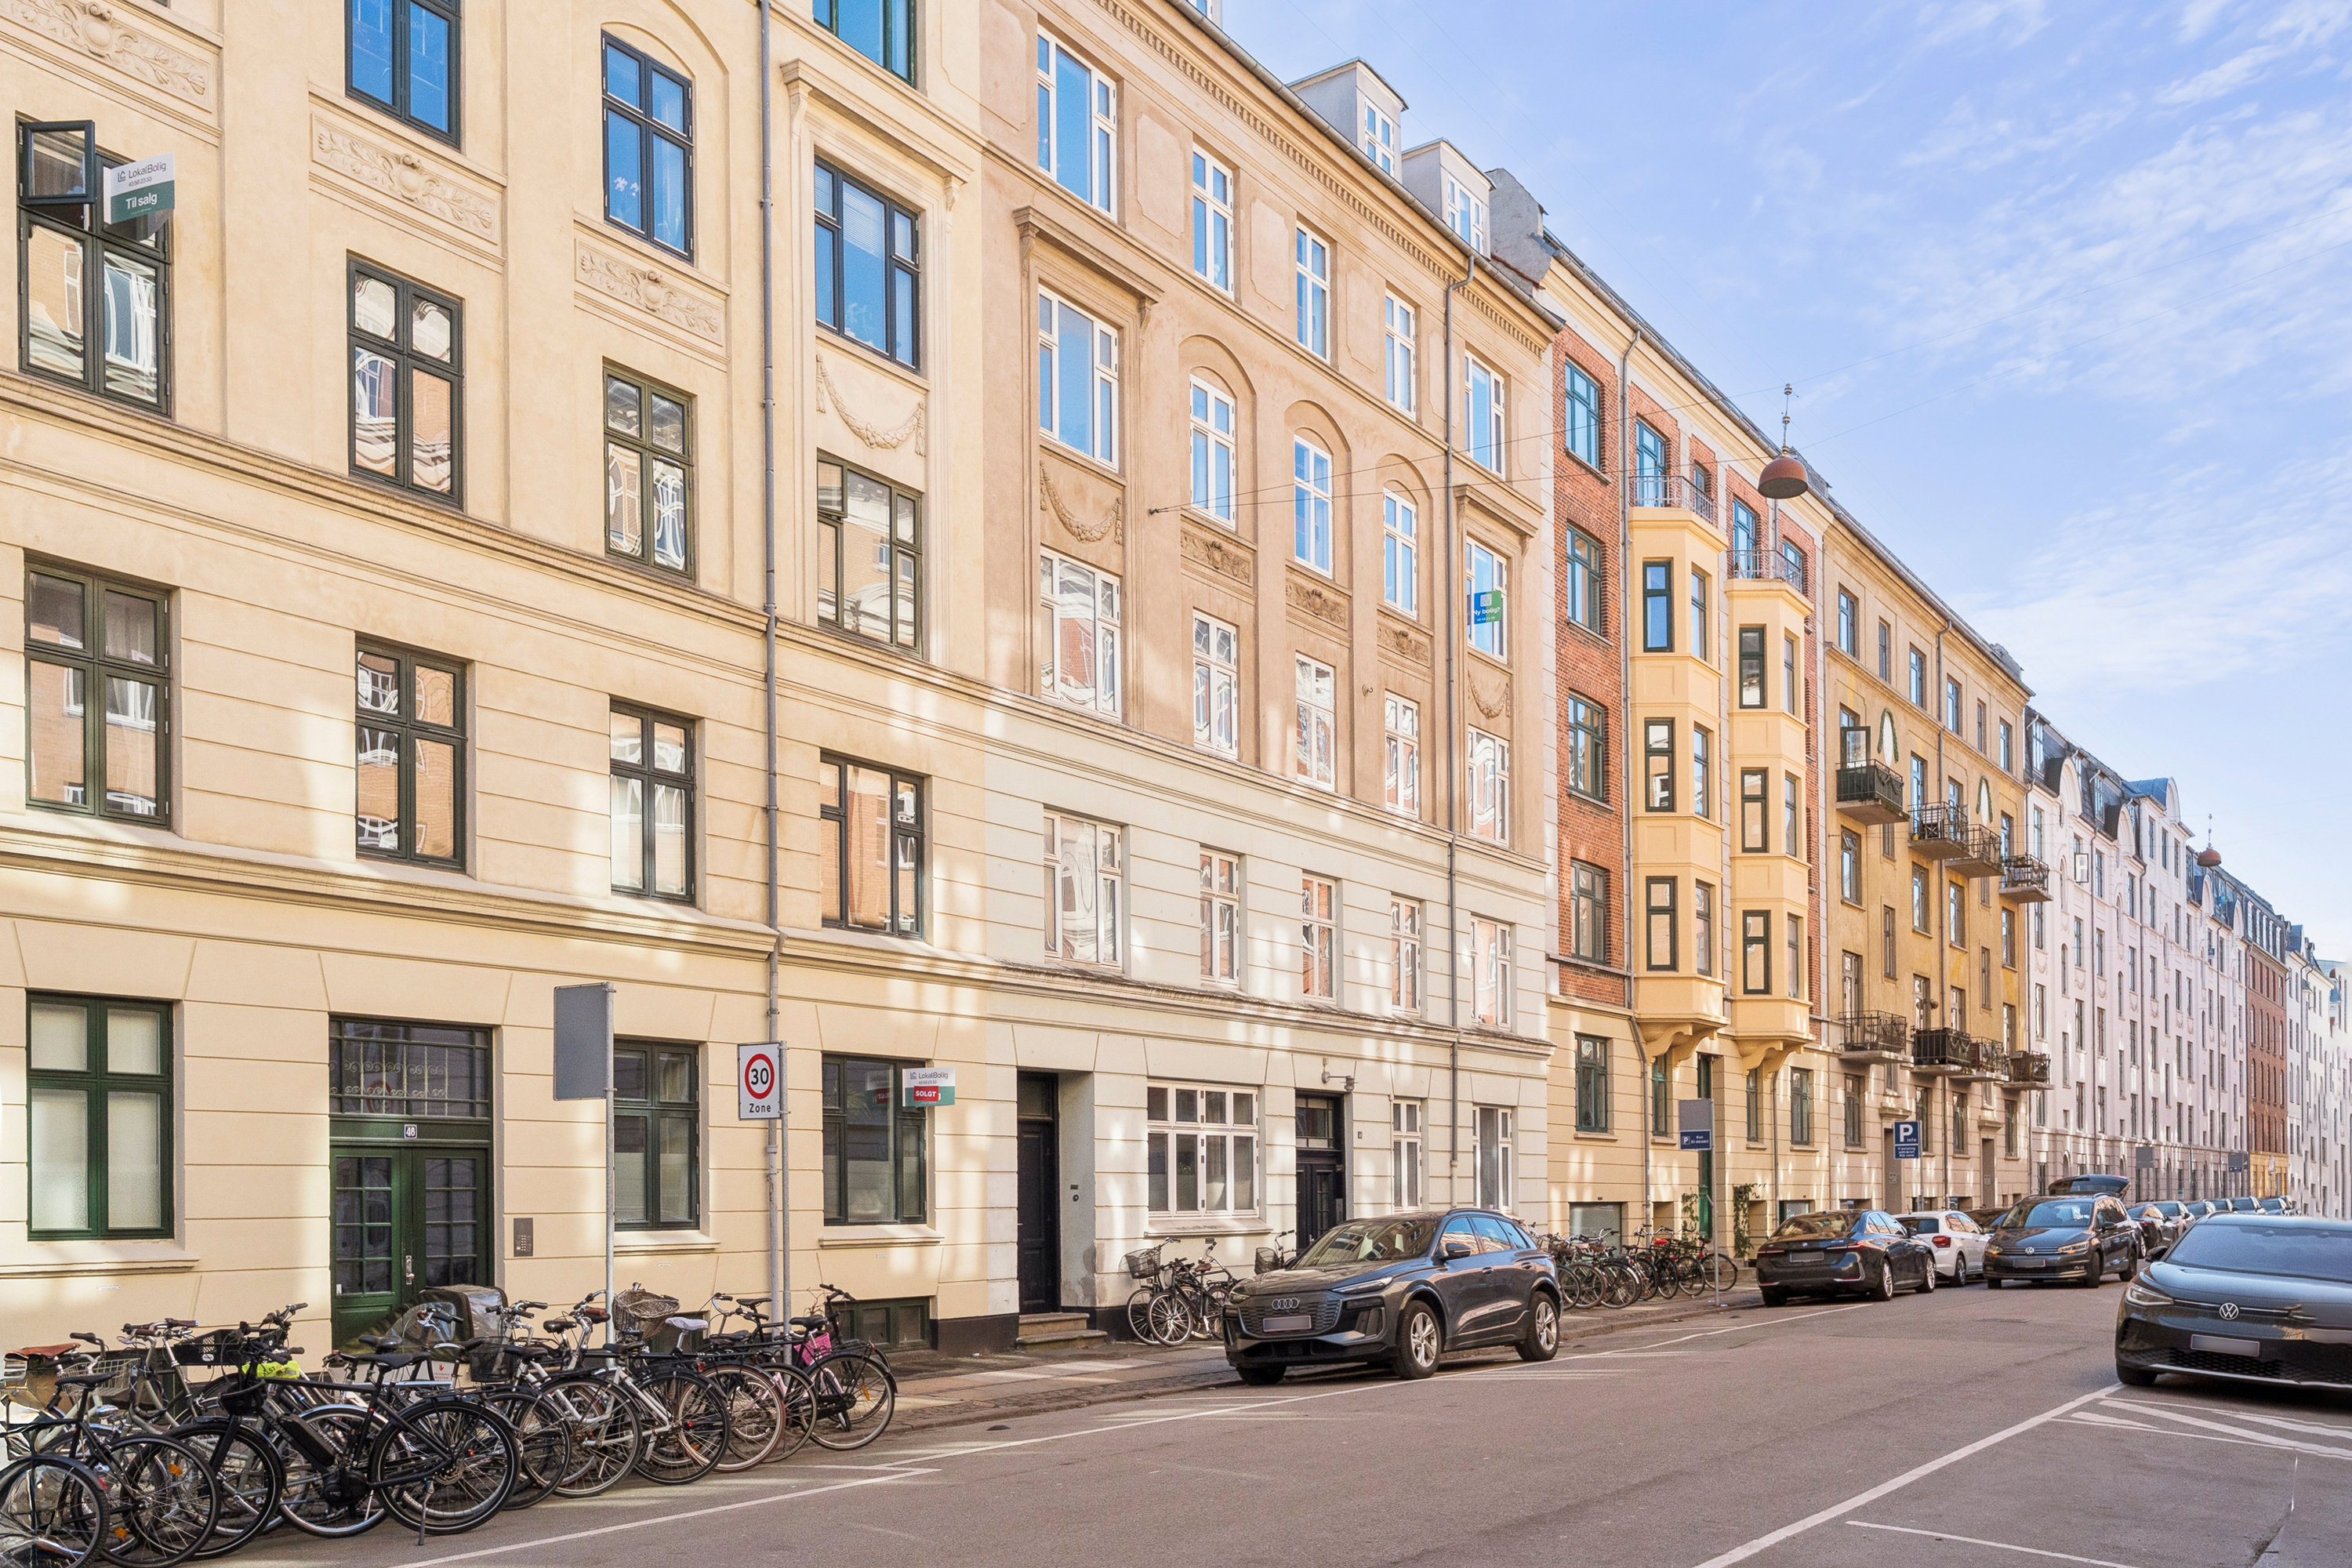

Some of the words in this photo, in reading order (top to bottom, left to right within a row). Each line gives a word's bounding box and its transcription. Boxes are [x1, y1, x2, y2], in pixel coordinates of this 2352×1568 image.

[129, 162, 166, 179] LokalBolig
[125, 197, 137, 209] Til
[138, 192, 158, 206] salg
[750, 1068, 769, 1086] 30
[749, 1103, 771, 1112] Zone
[1900, 1124, 1914, 1142] P
